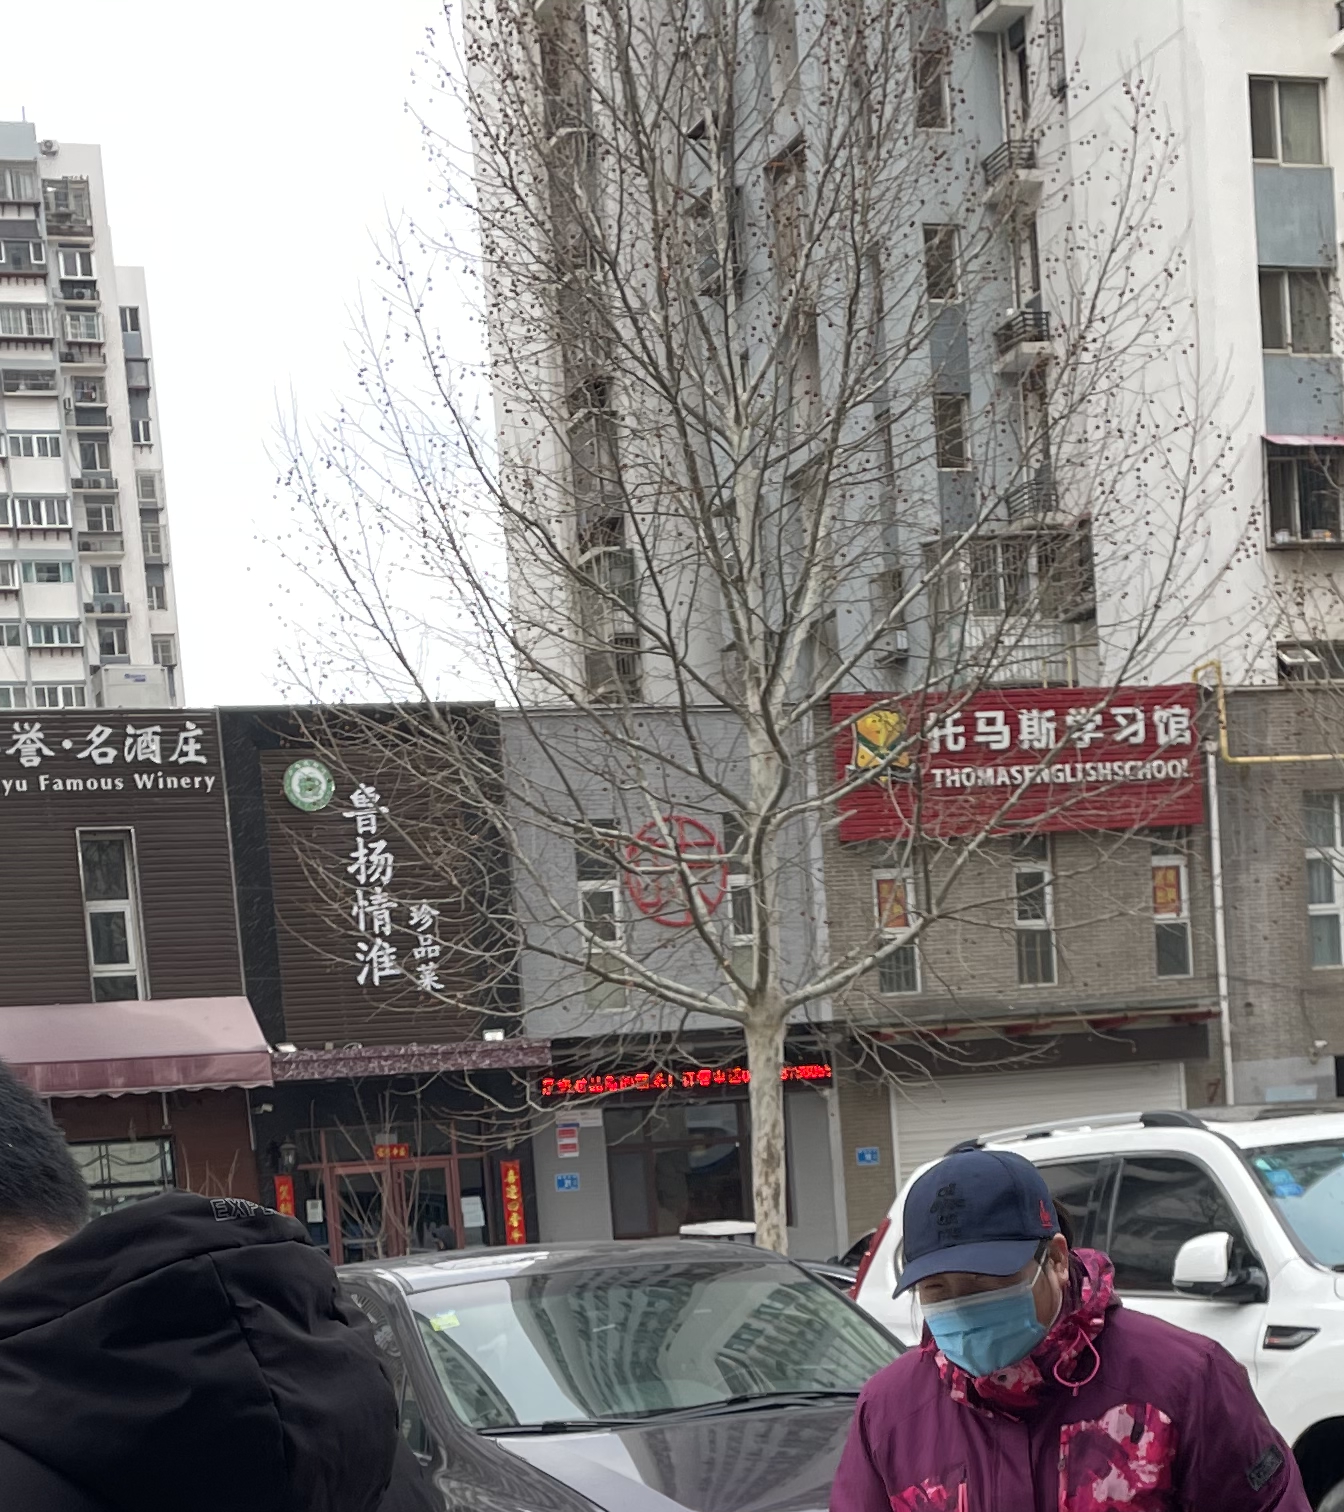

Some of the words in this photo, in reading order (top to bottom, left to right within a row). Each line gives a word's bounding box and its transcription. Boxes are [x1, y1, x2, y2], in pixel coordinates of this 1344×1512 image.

[927, 704, 1193, 753] 托马斯学习馆
[39, 773, 124, 792] Famous
[134, 771, 216, 793] Winery
